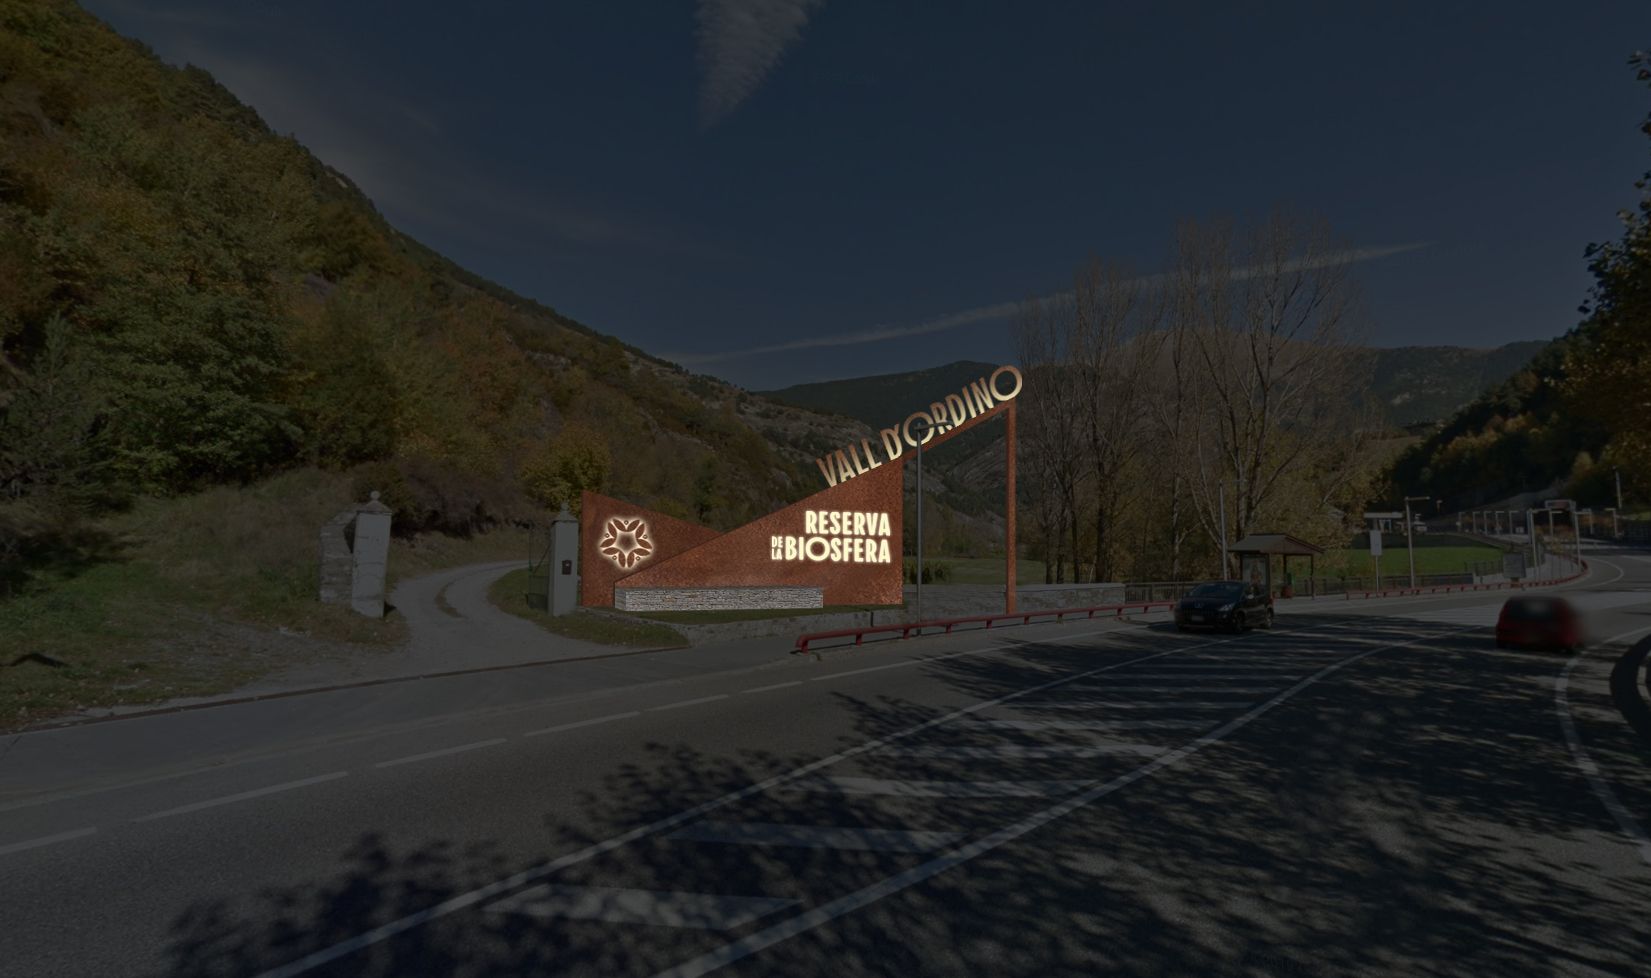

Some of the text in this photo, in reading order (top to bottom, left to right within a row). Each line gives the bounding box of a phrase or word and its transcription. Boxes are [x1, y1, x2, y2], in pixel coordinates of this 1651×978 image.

[816, 365, 1022, 487] VALL D'ORDINO
[805, 510, 891, 536] RESERVA
[771, 536, 783, 548] DE
[771, 548, 783, 560] LA
[785, 536, 891, 563] BIOSFERA
